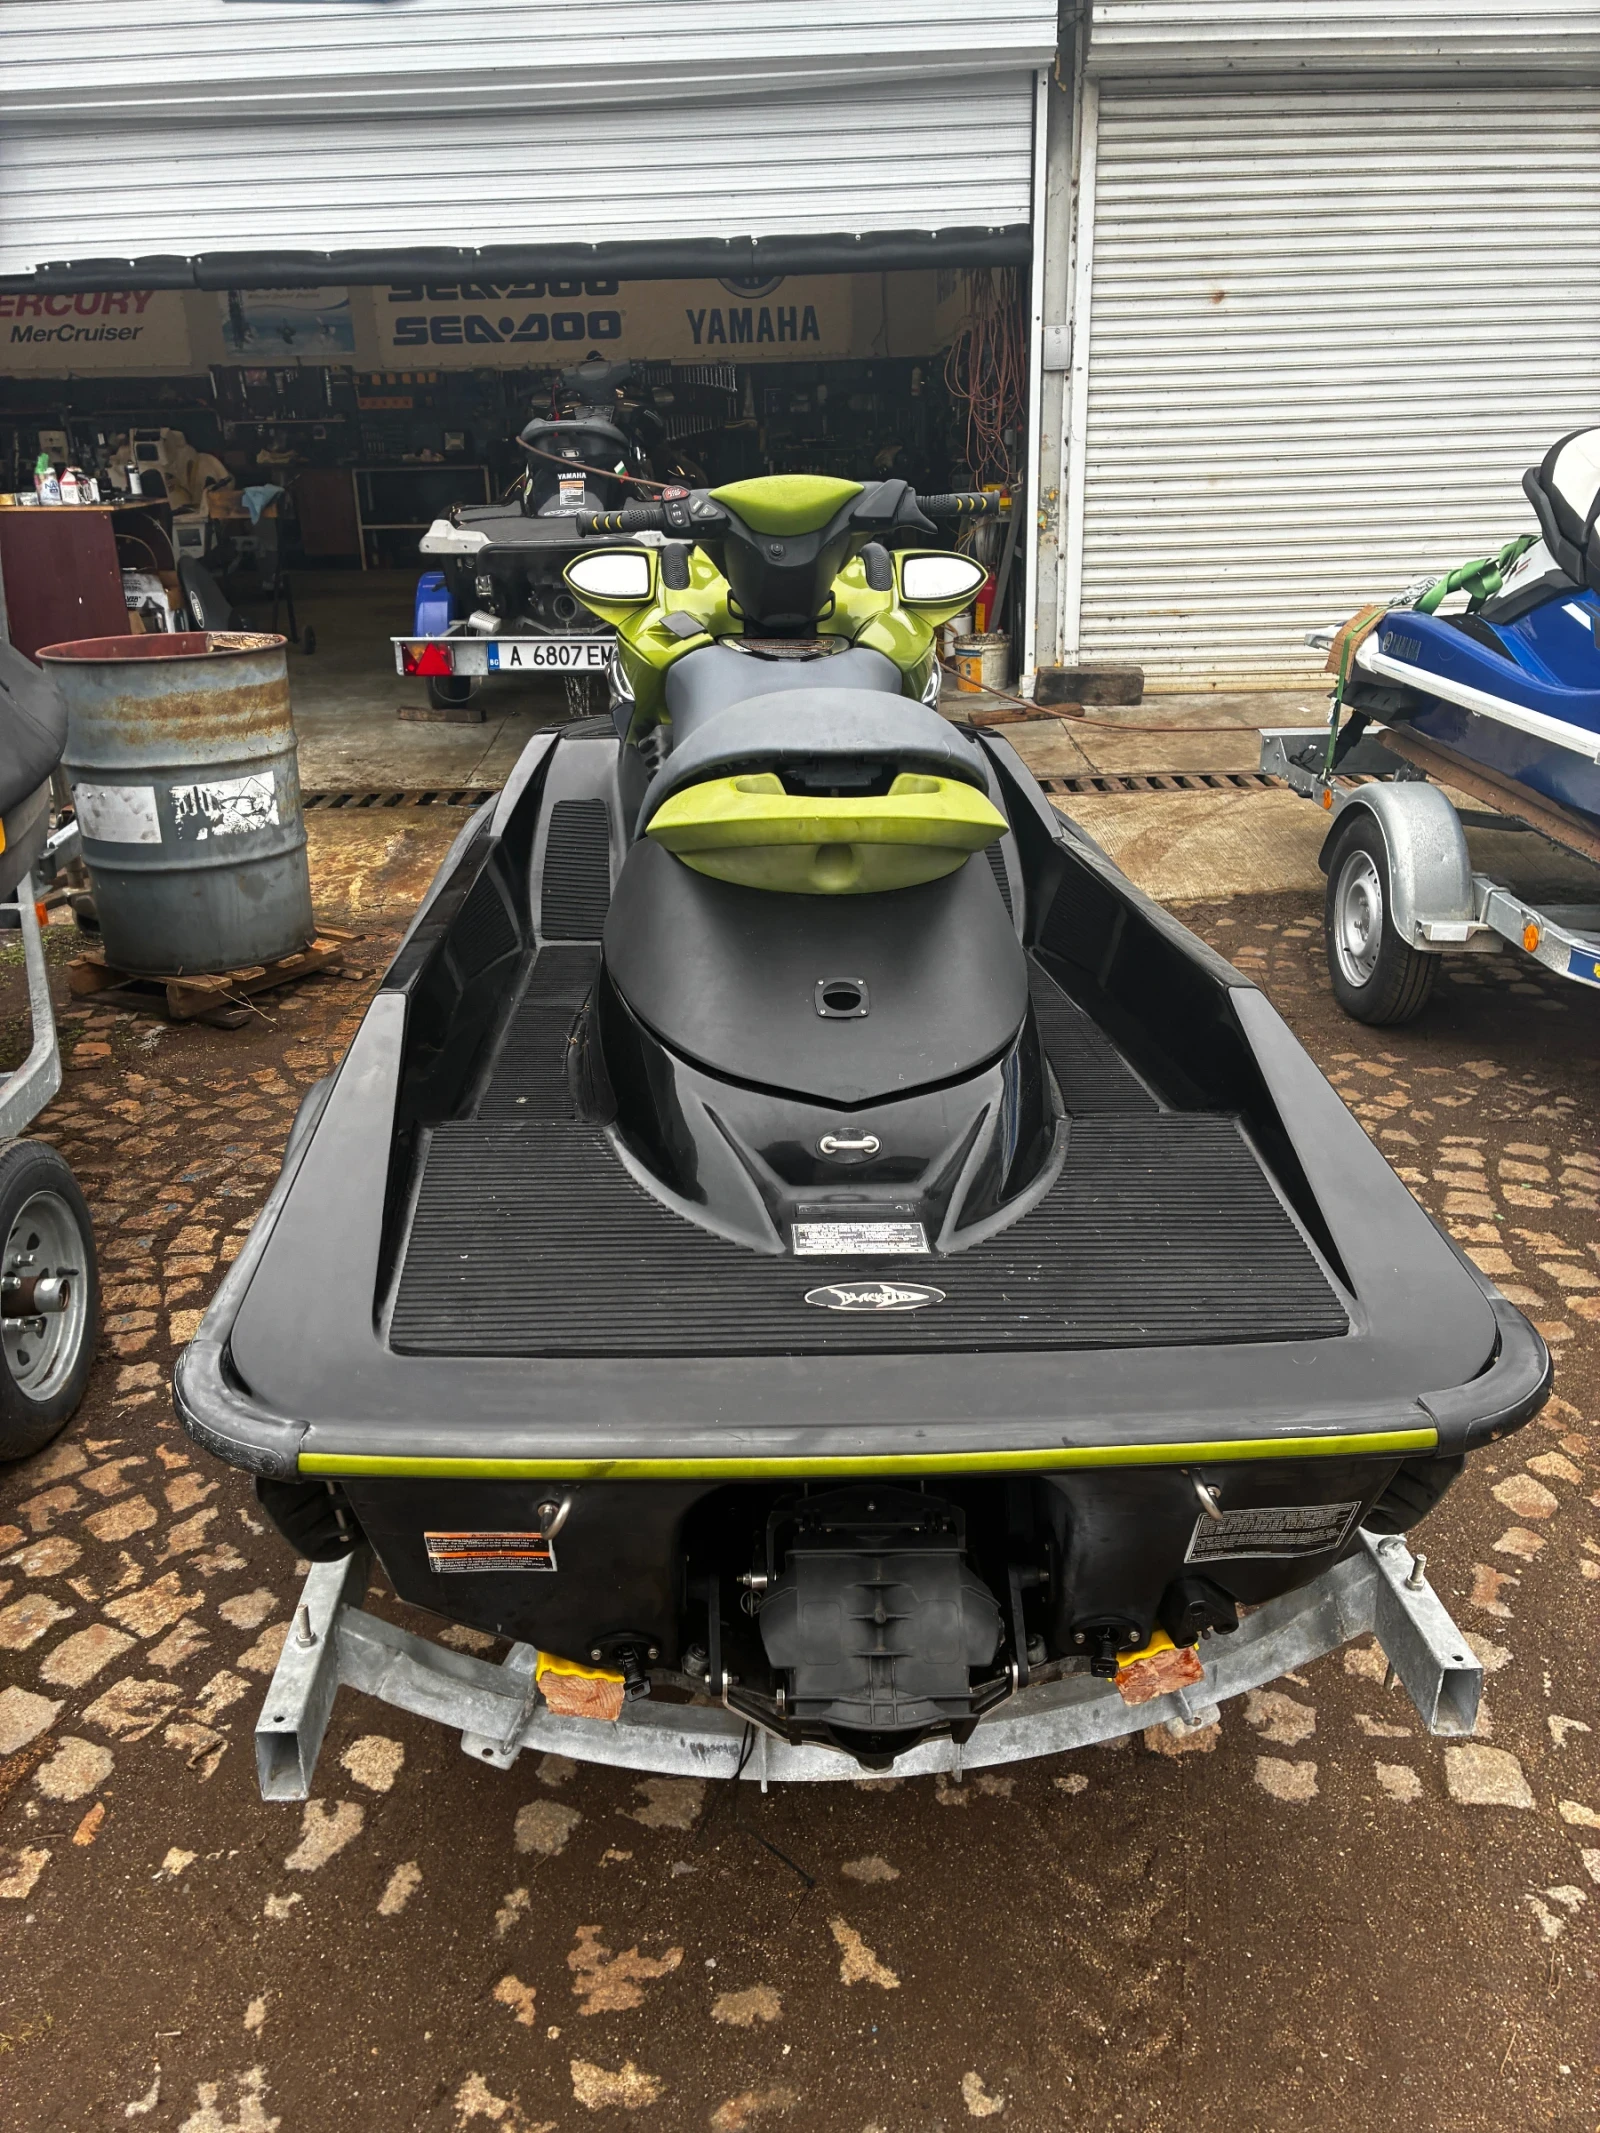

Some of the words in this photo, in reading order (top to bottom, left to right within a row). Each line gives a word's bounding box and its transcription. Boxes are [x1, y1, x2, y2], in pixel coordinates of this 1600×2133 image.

[10, 324, 143, 343] MerCruiser
[686, 305, 820, 344] YAMAHA
[557, 472, 587, 480] YAMAHA
[489, 658, 499, 666] BG
[510, 645, 522, 666] A
[533, 645, 582, 666] 6807
